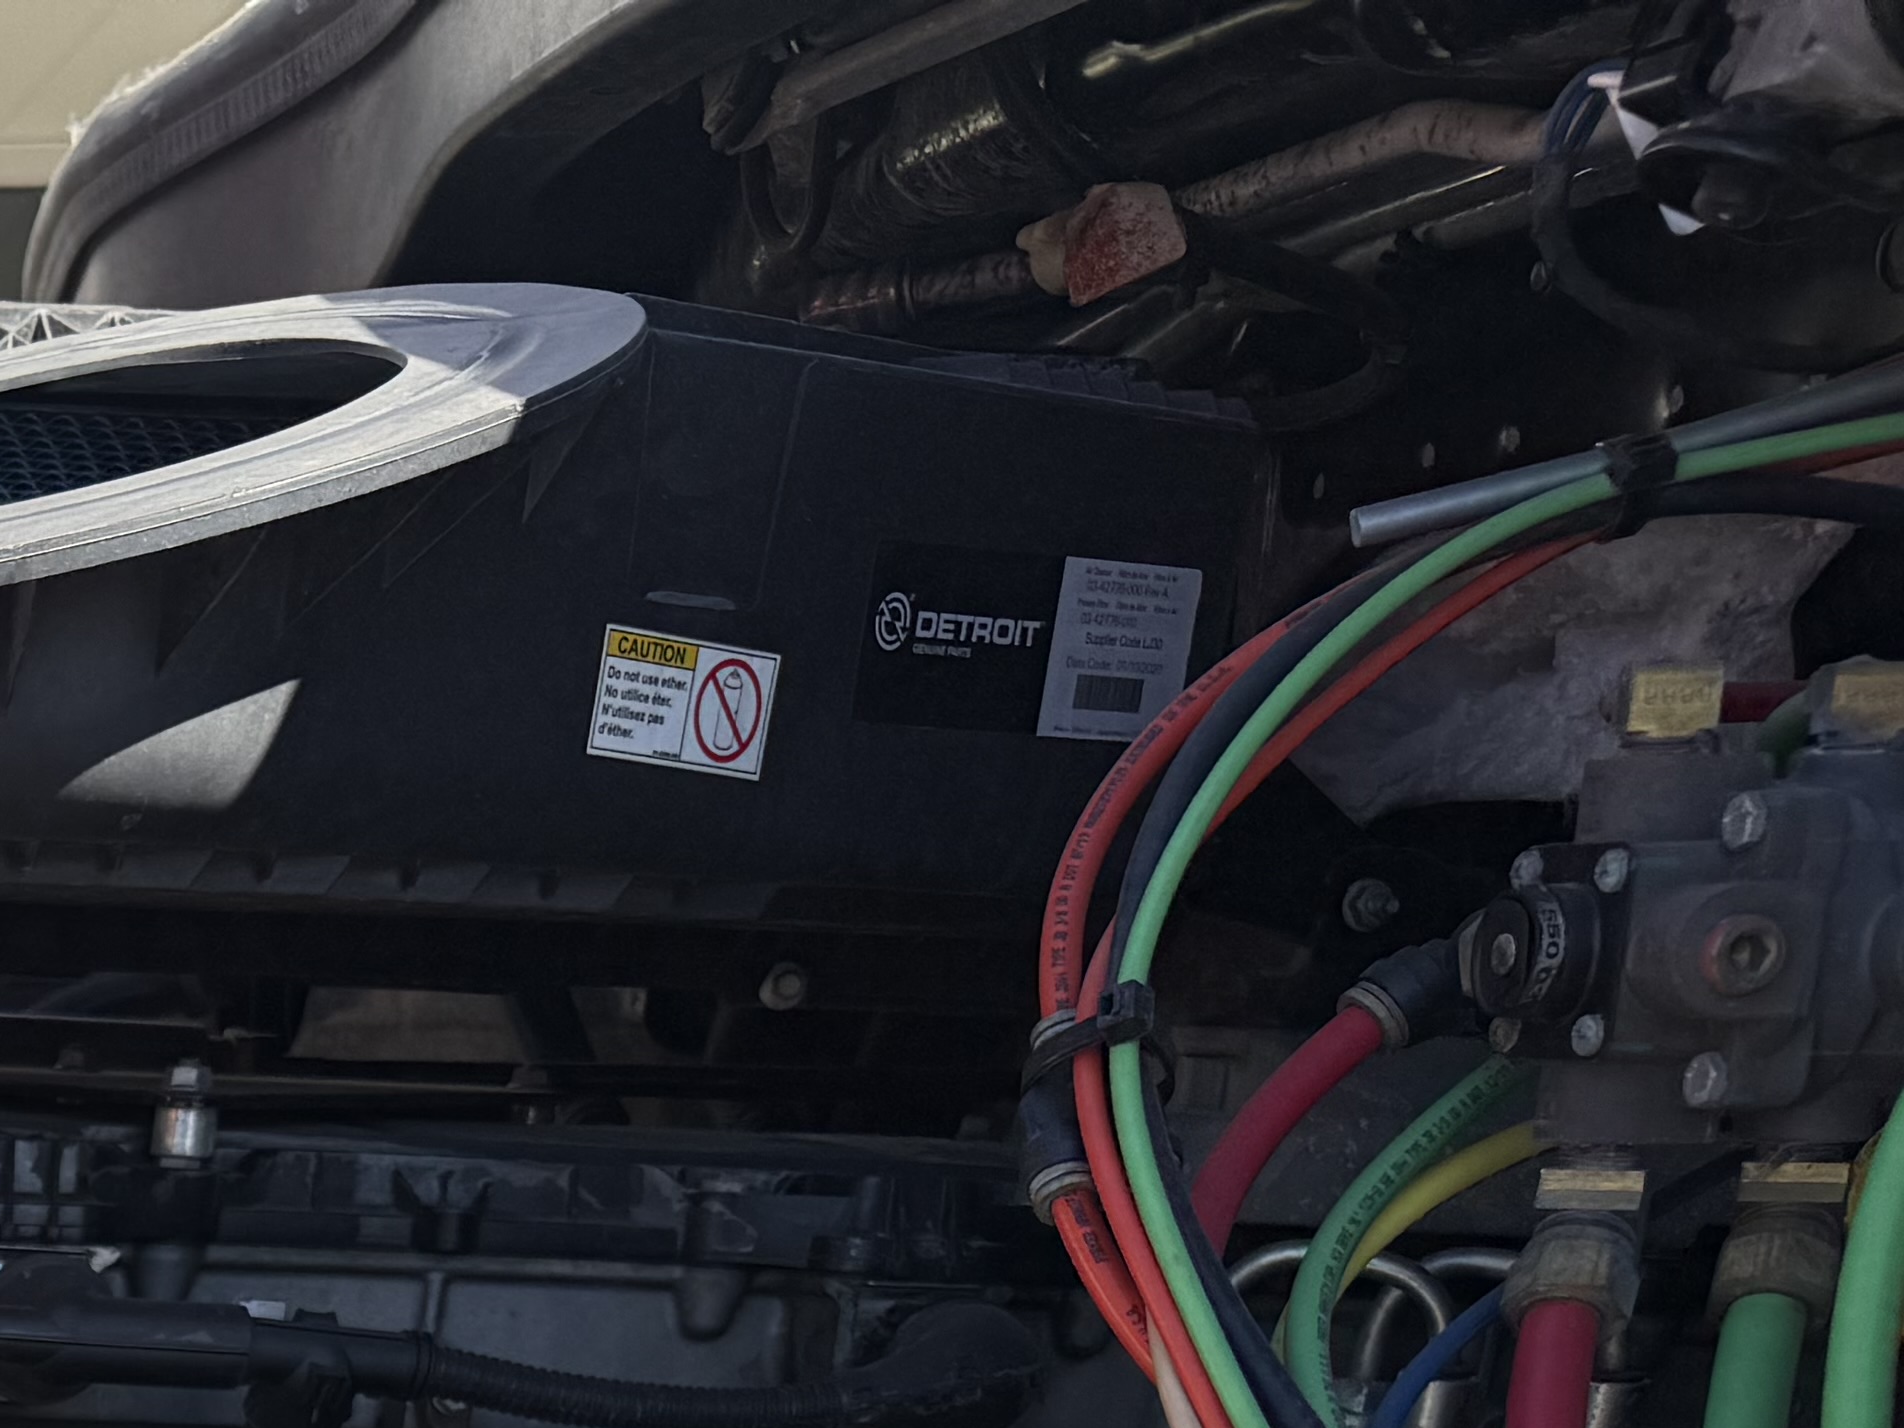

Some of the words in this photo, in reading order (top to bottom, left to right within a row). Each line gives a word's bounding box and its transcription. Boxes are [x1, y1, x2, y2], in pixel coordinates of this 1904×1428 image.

[915, 610, 1041, 647] DETROIT
[1085, 632, 1118, 647] Supplier
[1119, 635, 1142, 649] Code
[618, 636, 687, 664] CAUTION
[607, 665, 621, 680] Do
[623, 670, 641, 683] not
[641, 675, 660, 687] use
[661, 675, 688, 692] ether.
[604, 684, 619, 699] No
[620, 688, 650, 705] utilice
[601, 703, 645, 722] N'utilisez
[647, 714, 665, 726] pas
